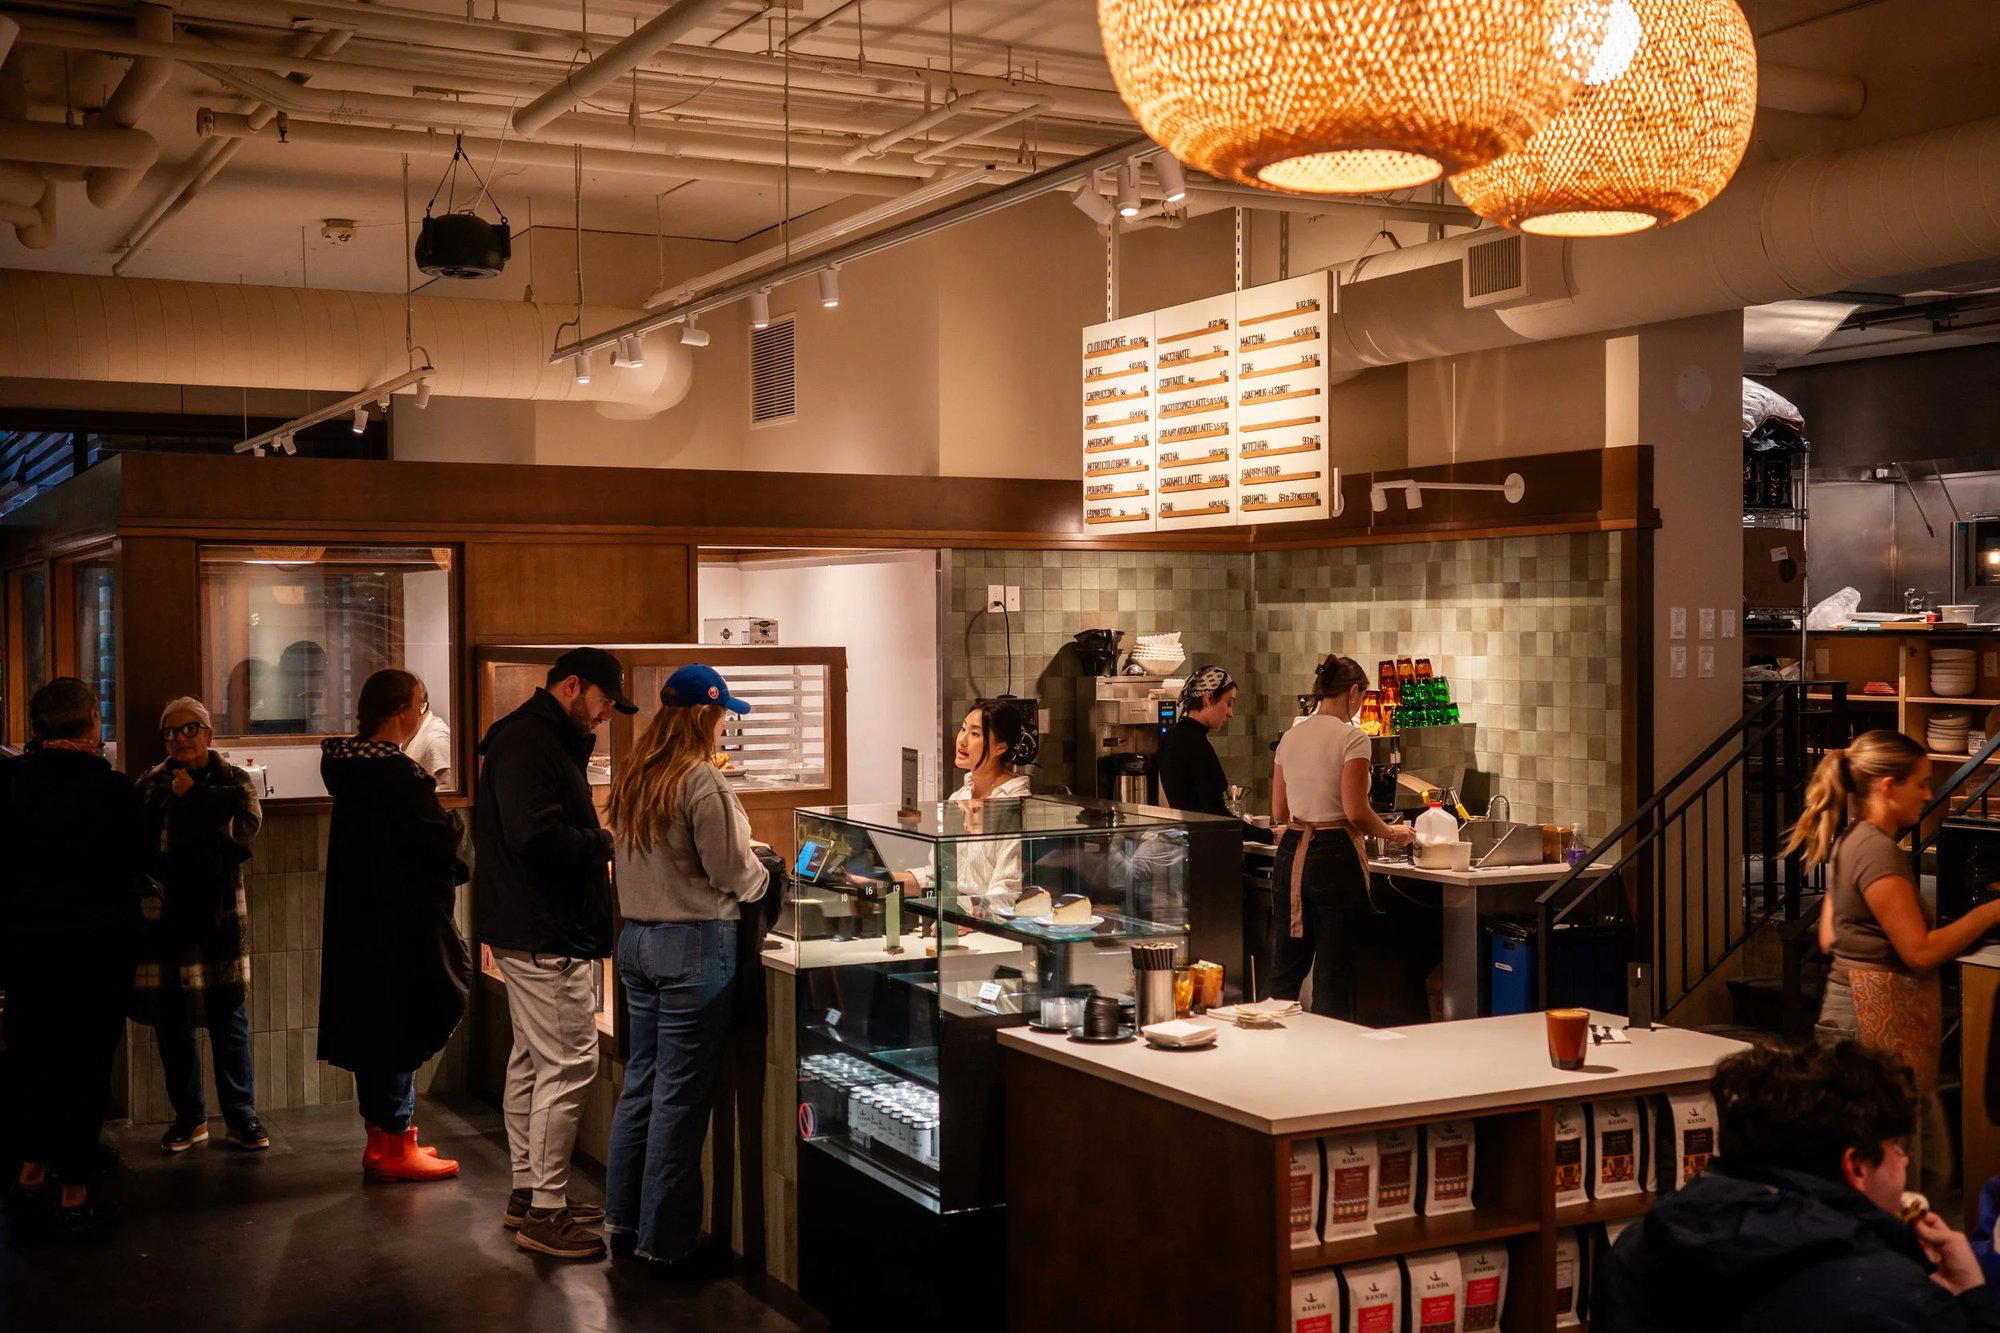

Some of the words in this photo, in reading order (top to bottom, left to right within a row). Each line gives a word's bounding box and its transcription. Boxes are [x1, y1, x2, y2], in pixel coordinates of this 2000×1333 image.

[1240, 334, 1266, 348] MATCHA
[1159, 349, 1189, 363] MACCHIATO
[1086, 366, 1102, 378] LATTE
[1242, 363, 1253, 374] TEA
[1159, 375, 1184, 388] CORTADO
[1086, 388, 1117, 401] CAPPUCCINO
[1192, 397, 1207, 408] LATTE
[1197, 423, 1212, 433] LATTE
[1087, 436, 1114, 448] AMERICANO
[1242, 440, 1268, 453] KITCHEN
[1160, 452, 1179, 463] MOCHA
[1087, 461, 1102, 472] NITRO
[1103, 460, 1115, 470] COLD
[1242, 467, 1261, 479] HAPPY
[1261, 465, 1281, 477] HOUR
[1160, 476, 1183, 488] CARAMEL
[1185, 474, 1202, 485] LATTE
[1242, 493, 1268, 505] BRUNCH
[1087, 508, 1112, 518] ESPRESSO
[1161, 503, 1173, 513] CHAI
[866, 887, 873, 895] 16
[926, 891, 933, 899] 17
[841, 893, 848, 902] 10
[1473, 1265, 1496, 1274] BANDA
[1426, 1281, 1450, 1290] BANDA
[1365, 1292, 1388, 1301] BANDA
[1302, 1303, 1326, 1313] BANDA
